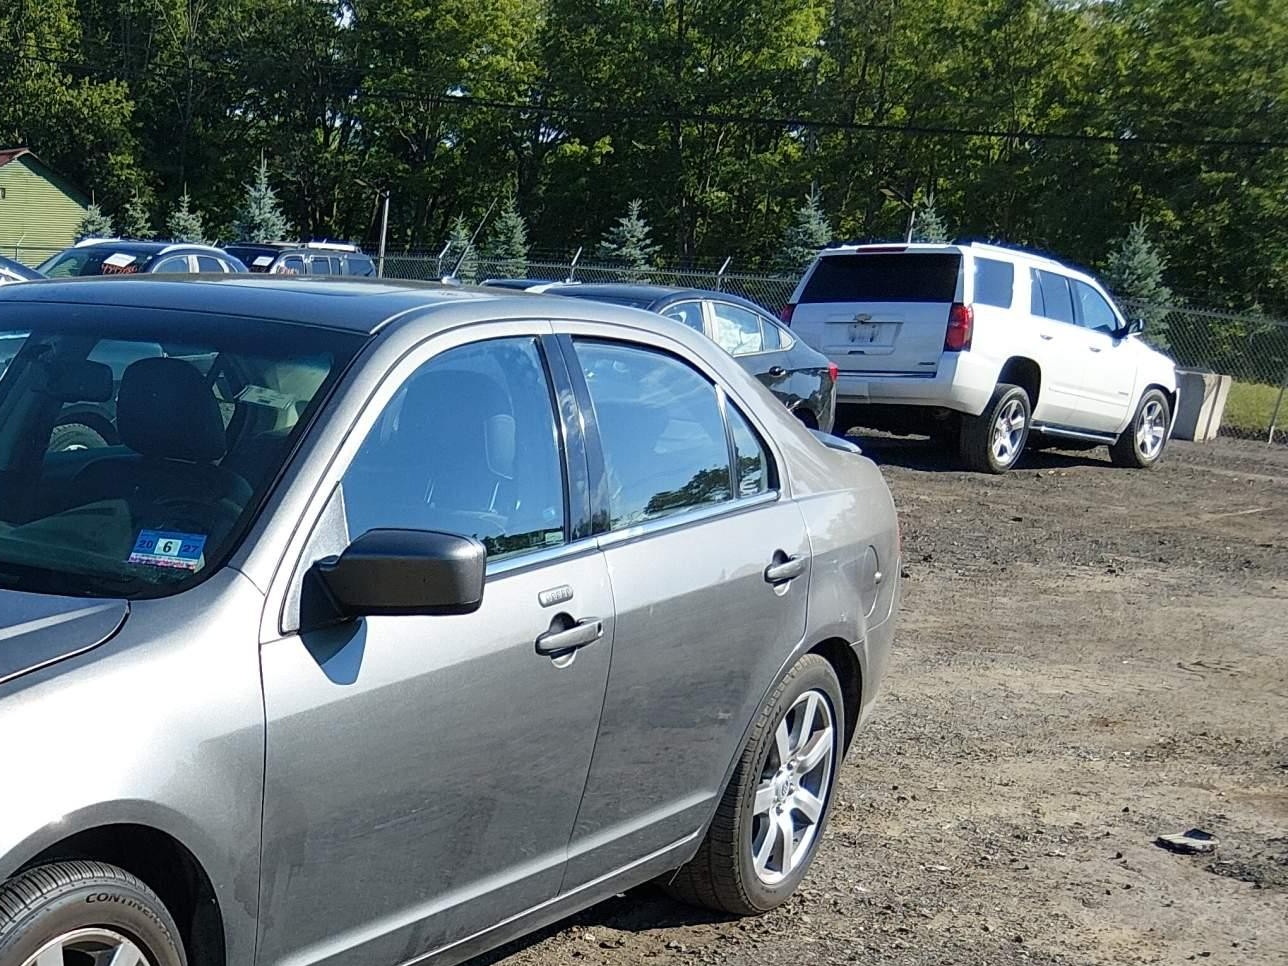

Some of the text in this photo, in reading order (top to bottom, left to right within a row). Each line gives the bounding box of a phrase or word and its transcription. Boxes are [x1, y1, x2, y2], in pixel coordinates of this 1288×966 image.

[136, 540, 200, 553] 20 6 27
